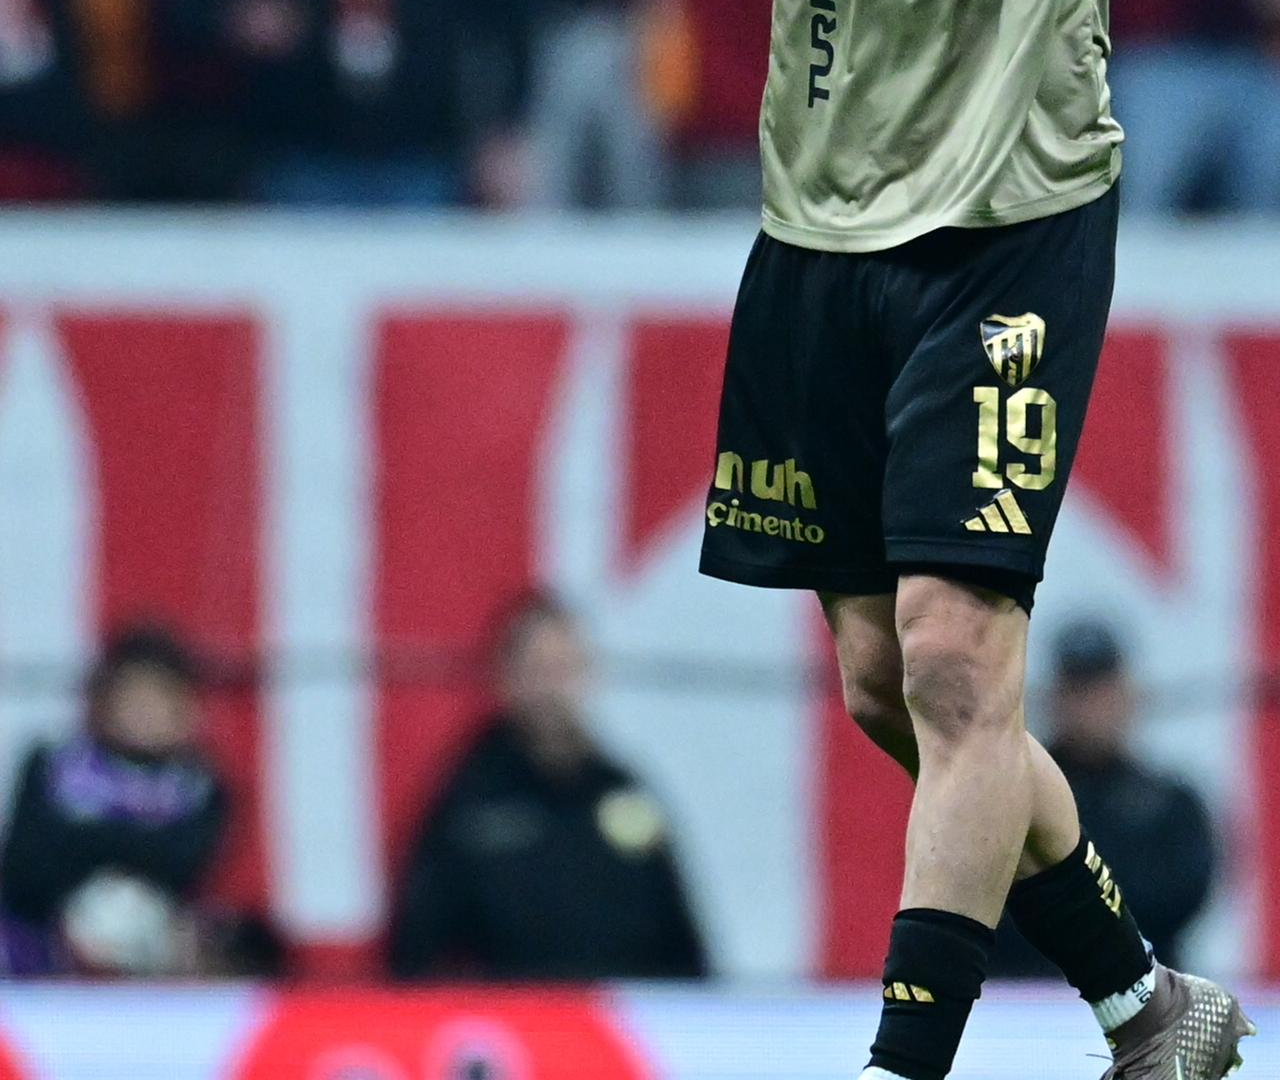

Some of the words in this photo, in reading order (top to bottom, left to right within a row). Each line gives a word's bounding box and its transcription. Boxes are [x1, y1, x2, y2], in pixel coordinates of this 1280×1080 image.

[972, 386, 1057, 490] 19
[714, 451, 817, 509] nuh
[706, 499, 825, 544] çimento
